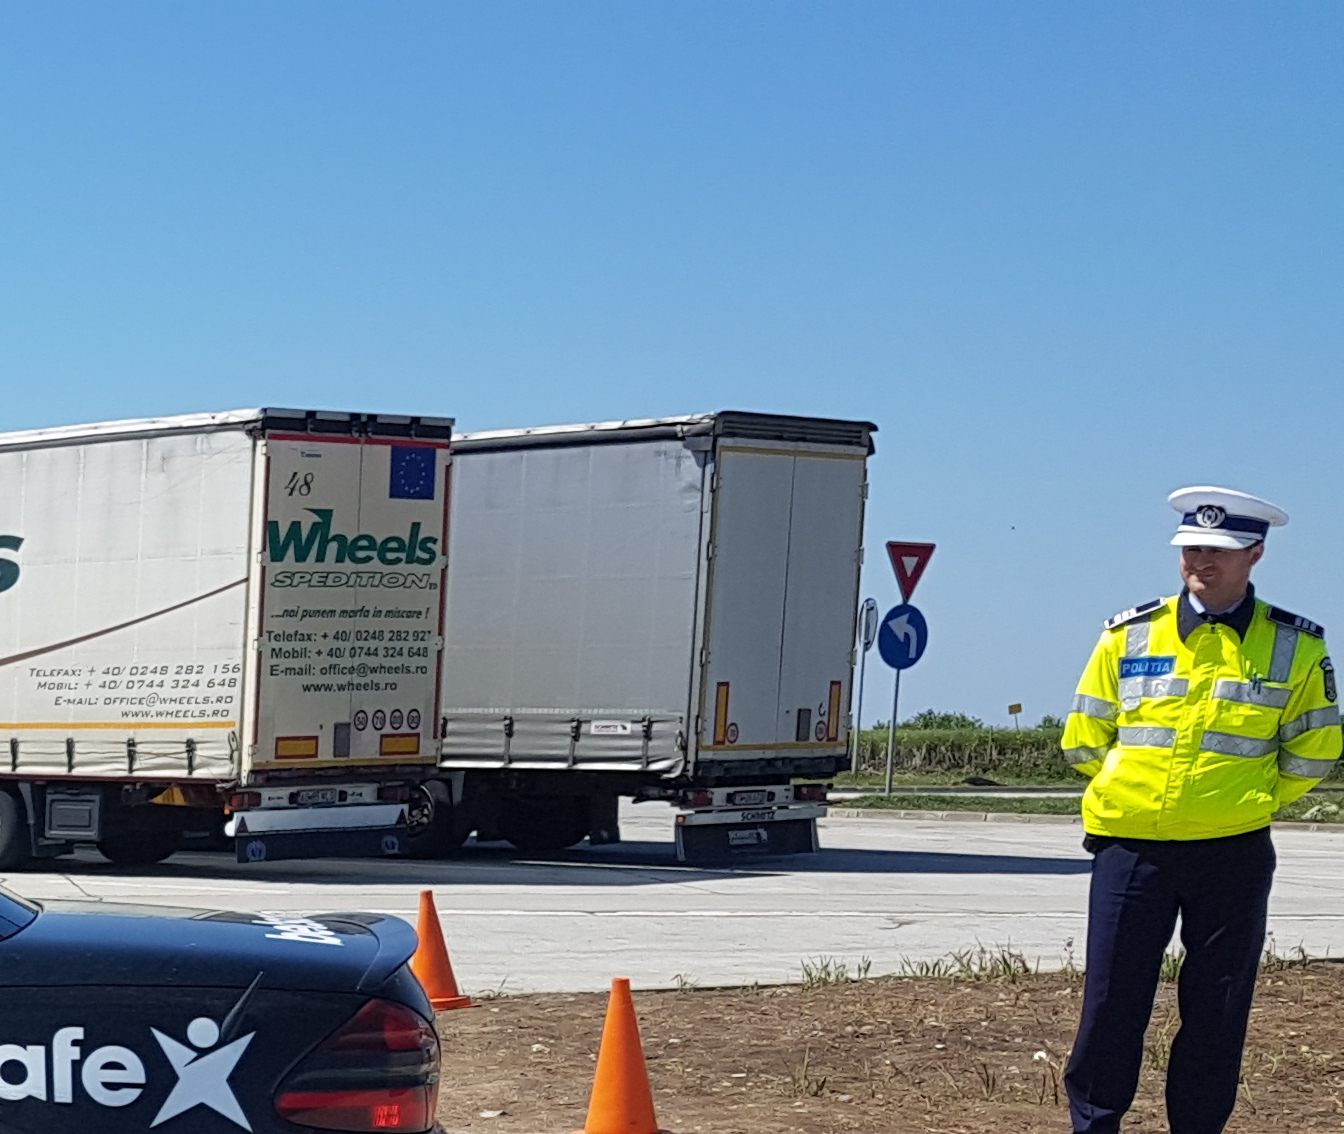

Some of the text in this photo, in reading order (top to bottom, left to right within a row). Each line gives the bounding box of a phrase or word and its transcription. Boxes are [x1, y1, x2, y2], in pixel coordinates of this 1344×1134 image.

[284, 471, 314, 496] 48
[268, 507, 438, 565] Wheels
[271, 571, 430, 590] SPEDITION
[300, 607, 336, 621] punem
[339, 606, 369, 618] marfa
[372, 606, 382, 618] in
[384, 606, 422, 619] miscare
[266, 630, 317, 642] Telefax:
[321, 632, 329, 641] +
[333, 631, 351, 643] 40/
[356, 630, 384, 642] 0248
[388, 630, 409, 642] 282
[270, 646, 429, 659] Mobil: + 40/ 0744 324 648
[88, 667, 96, 676] +
[102, 666, 126, 676] 40/
[129, 665, 168, 676] 0248
[175, 664, 204, 675] 282
[212, 663, 241, 674] 156
[269, 662, 427, 678] E-mail: office@wheels.ro
[84, 681, 93, 690] +
[98, 680, 123, 690] 40/
[126, 679, 165, 690] 0744
[170, 678, 200, 689] 324
[206, 677, 237, 688] 648
[302, 680, 398, 693] www.wheels.ro
